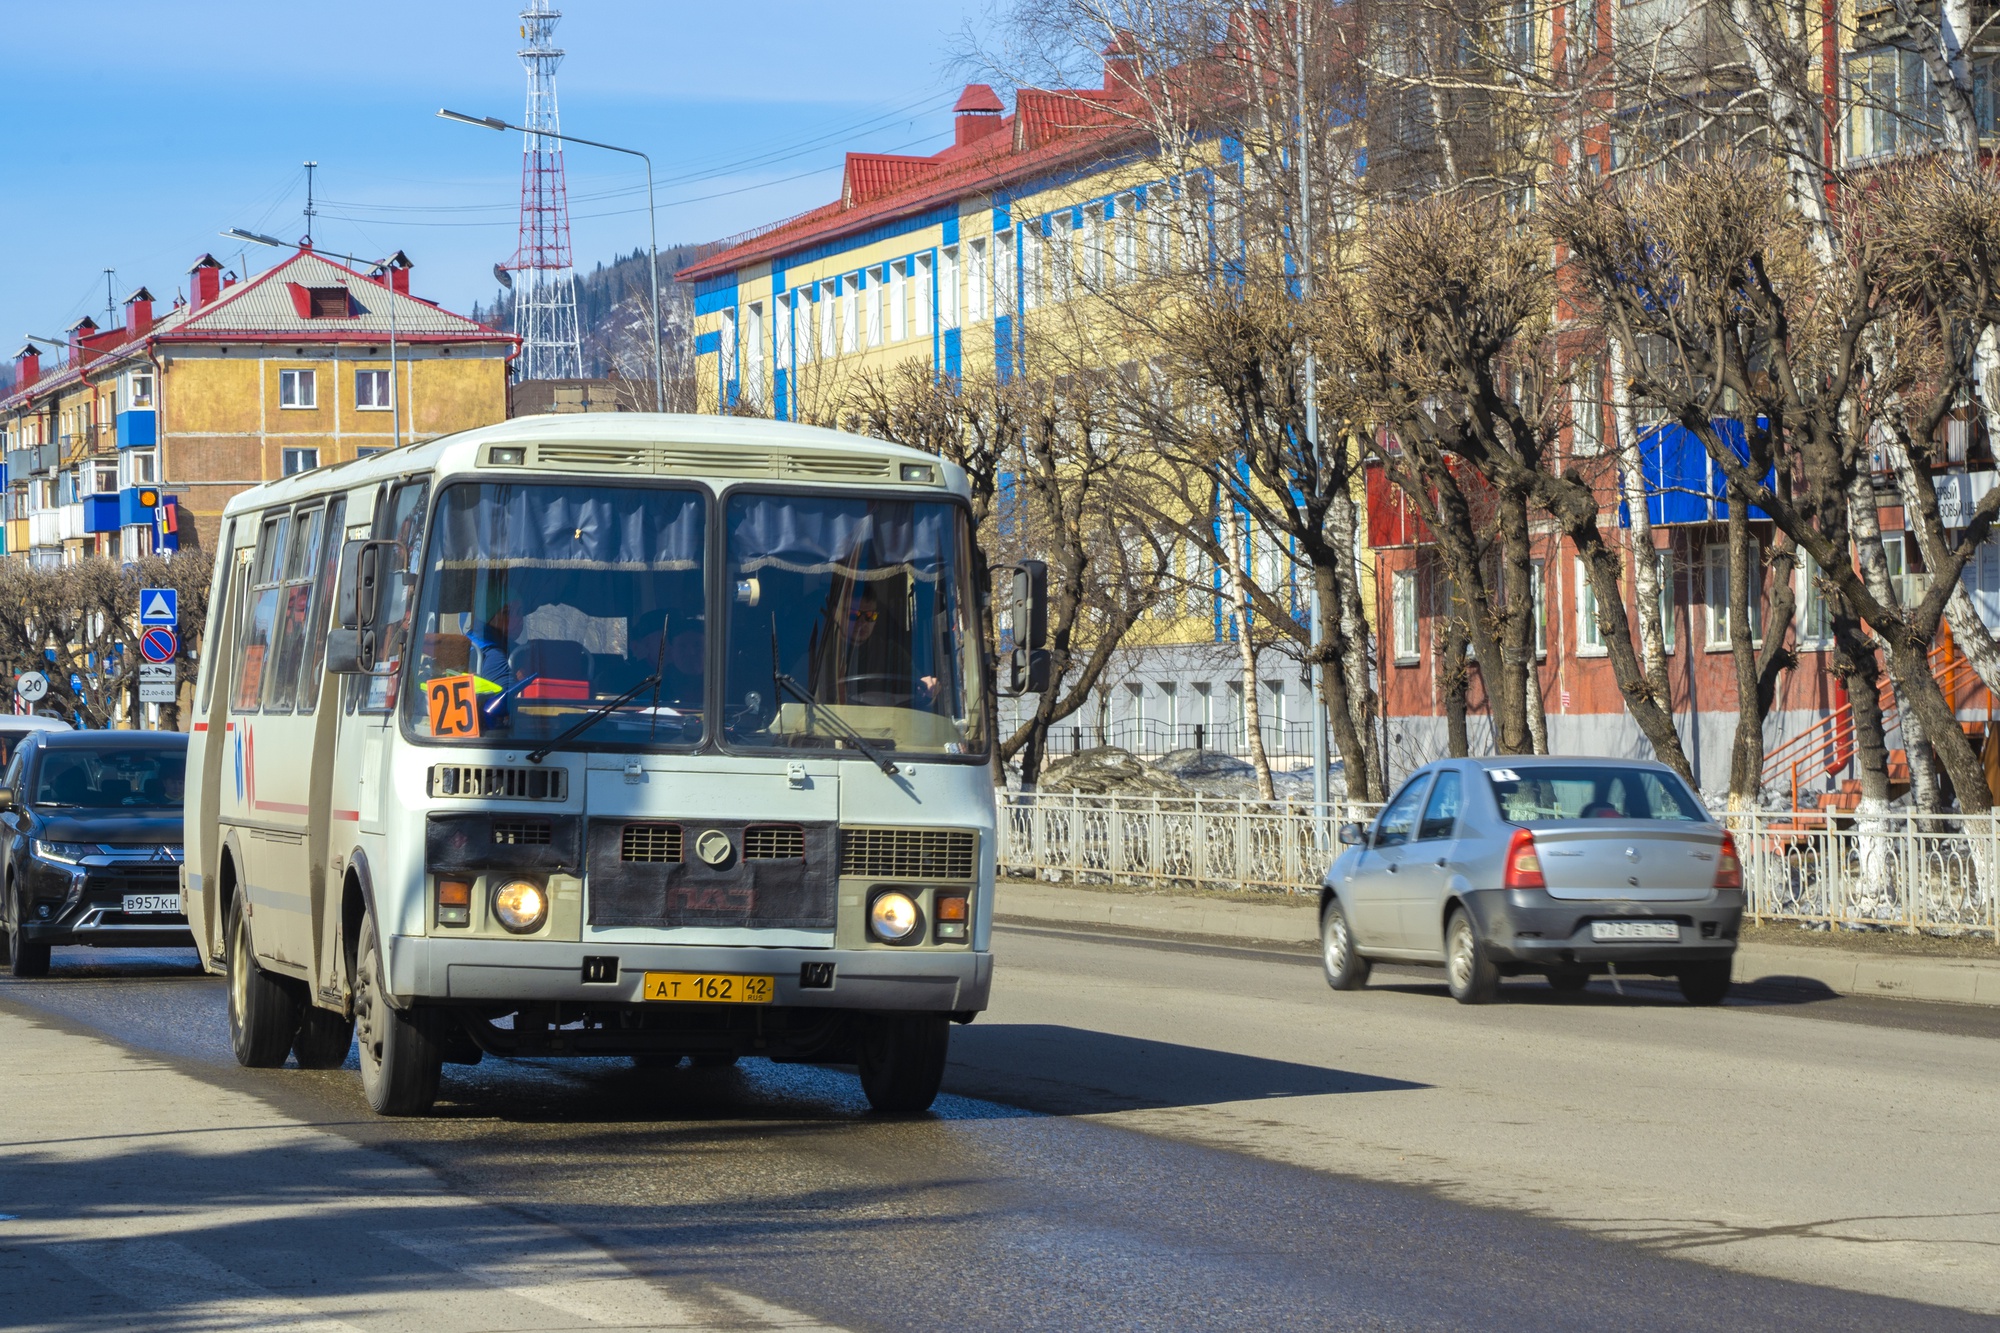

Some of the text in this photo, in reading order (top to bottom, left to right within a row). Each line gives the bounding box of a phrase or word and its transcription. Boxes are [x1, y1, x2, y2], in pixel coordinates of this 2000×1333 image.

[1936, 482, 1957, 501] ЕРВЫЙ
[1939, 500, 1963, 518] ЗОВЫЙ
[25, 680, 42, 692] 20
[141, 689, 174, 697] 22.00-6.00
[432, 681, 474, 735] 25
[127, 896, 177, 910] В957КН
[656, 977, 767, 999] АТ 162 42
